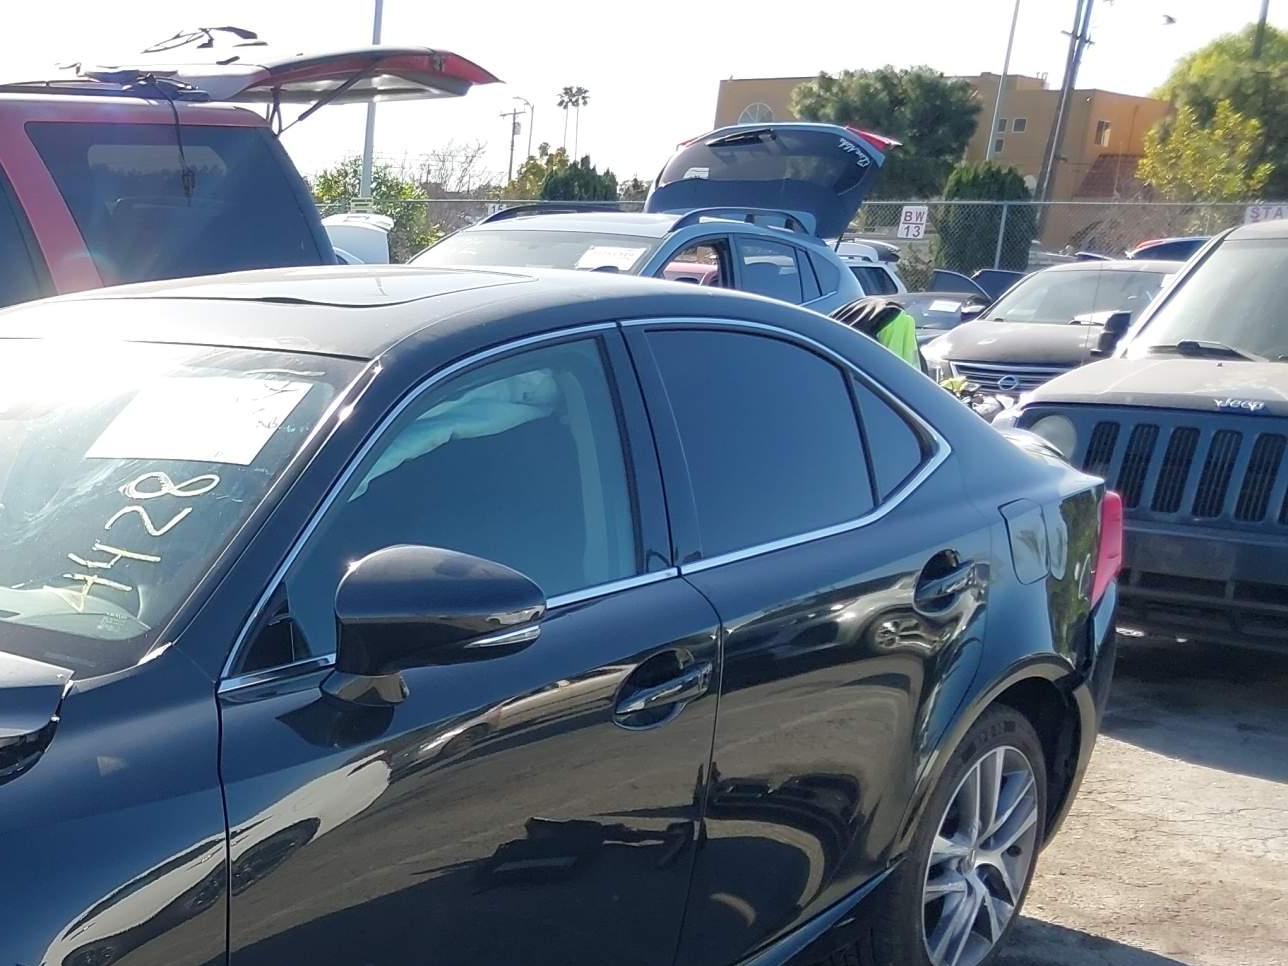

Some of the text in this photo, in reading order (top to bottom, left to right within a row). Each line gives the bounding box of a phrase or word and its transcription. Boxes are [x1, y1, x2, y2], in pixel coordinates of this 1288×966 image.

[903, 225, 921, 238] 13
[1214, 398, 1265, 411] Jeep
[43, 471, 221, 614] 4428
